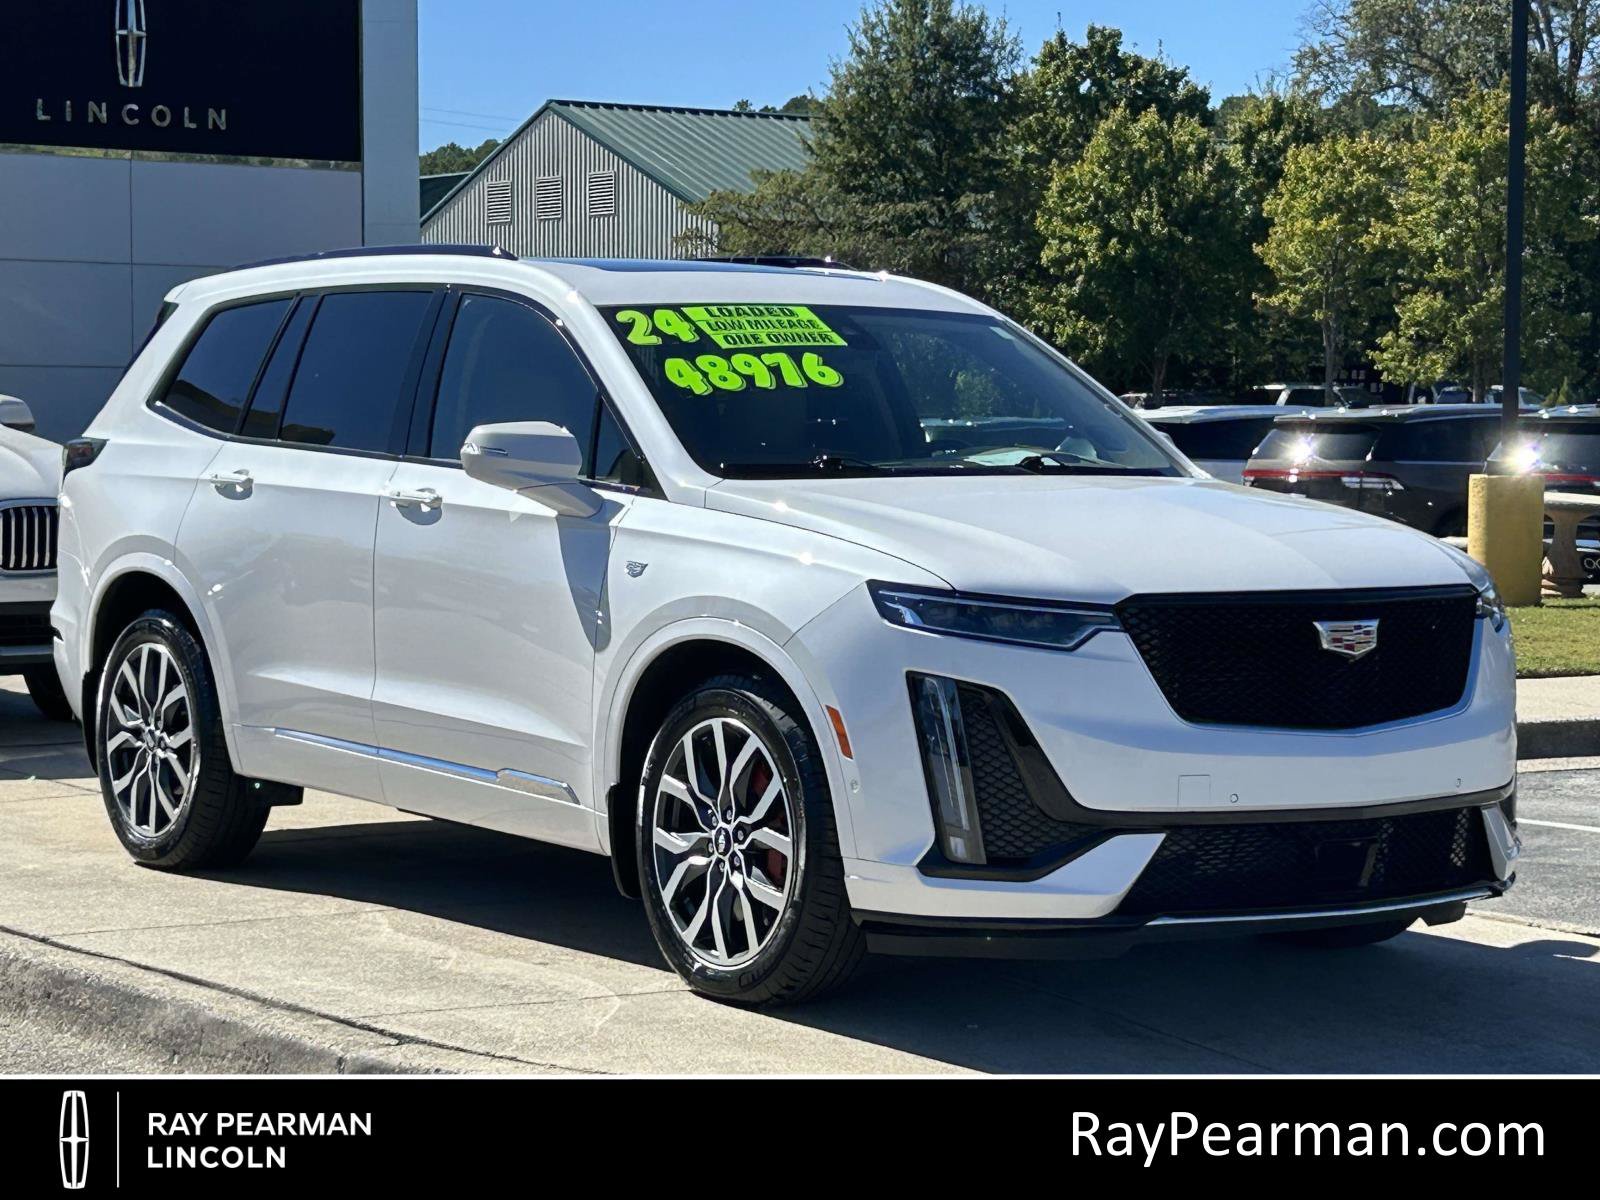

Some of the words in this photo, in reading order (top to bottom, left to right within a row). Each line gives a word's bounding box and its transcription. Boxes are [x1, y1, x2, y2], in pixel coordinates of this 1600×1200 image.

[36, 98, 227, 131] LINCOLN
[703, 306, 799, 319] LOADED
[615, 309, 699, 345] 24
[705, 319, 746, 332] LOW
[745, 318, 824, 331] MILEAGE
[721, 334, 764, 346] ONE
[764, 332, 834, 345] OWNER
[664, 352, 844, 396] 48976
